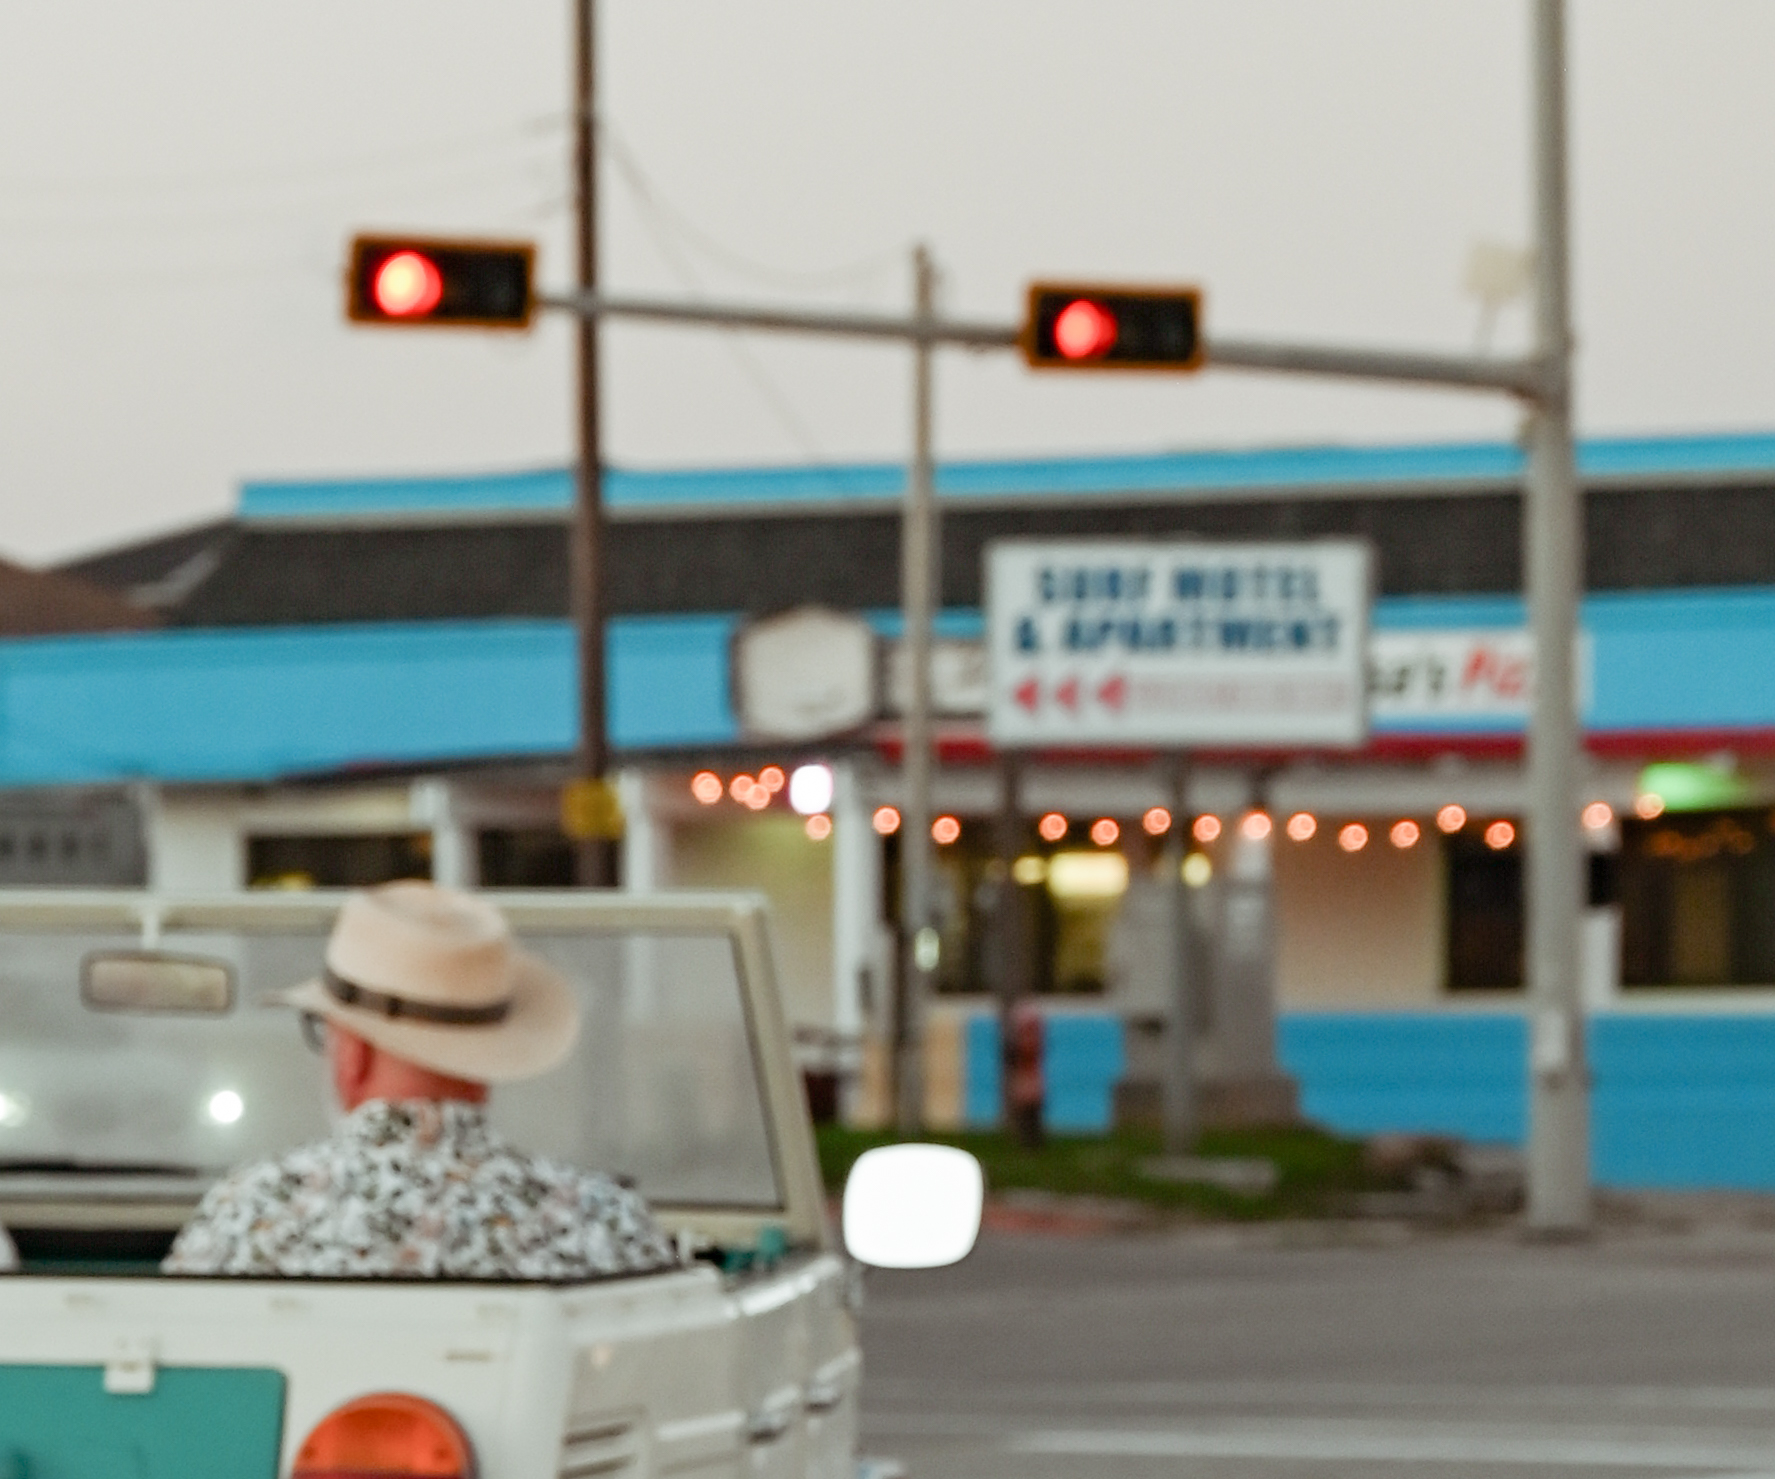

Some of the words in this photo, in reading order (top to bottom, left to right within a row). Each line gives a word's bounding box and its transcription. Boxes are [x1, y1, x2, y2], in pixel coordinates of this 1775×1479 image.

[1039, 566, 1151, 603] SURF
[1172, 566, 1320, 602] MOTEL
[1060, 617, 1342, 655] APARTMENT
